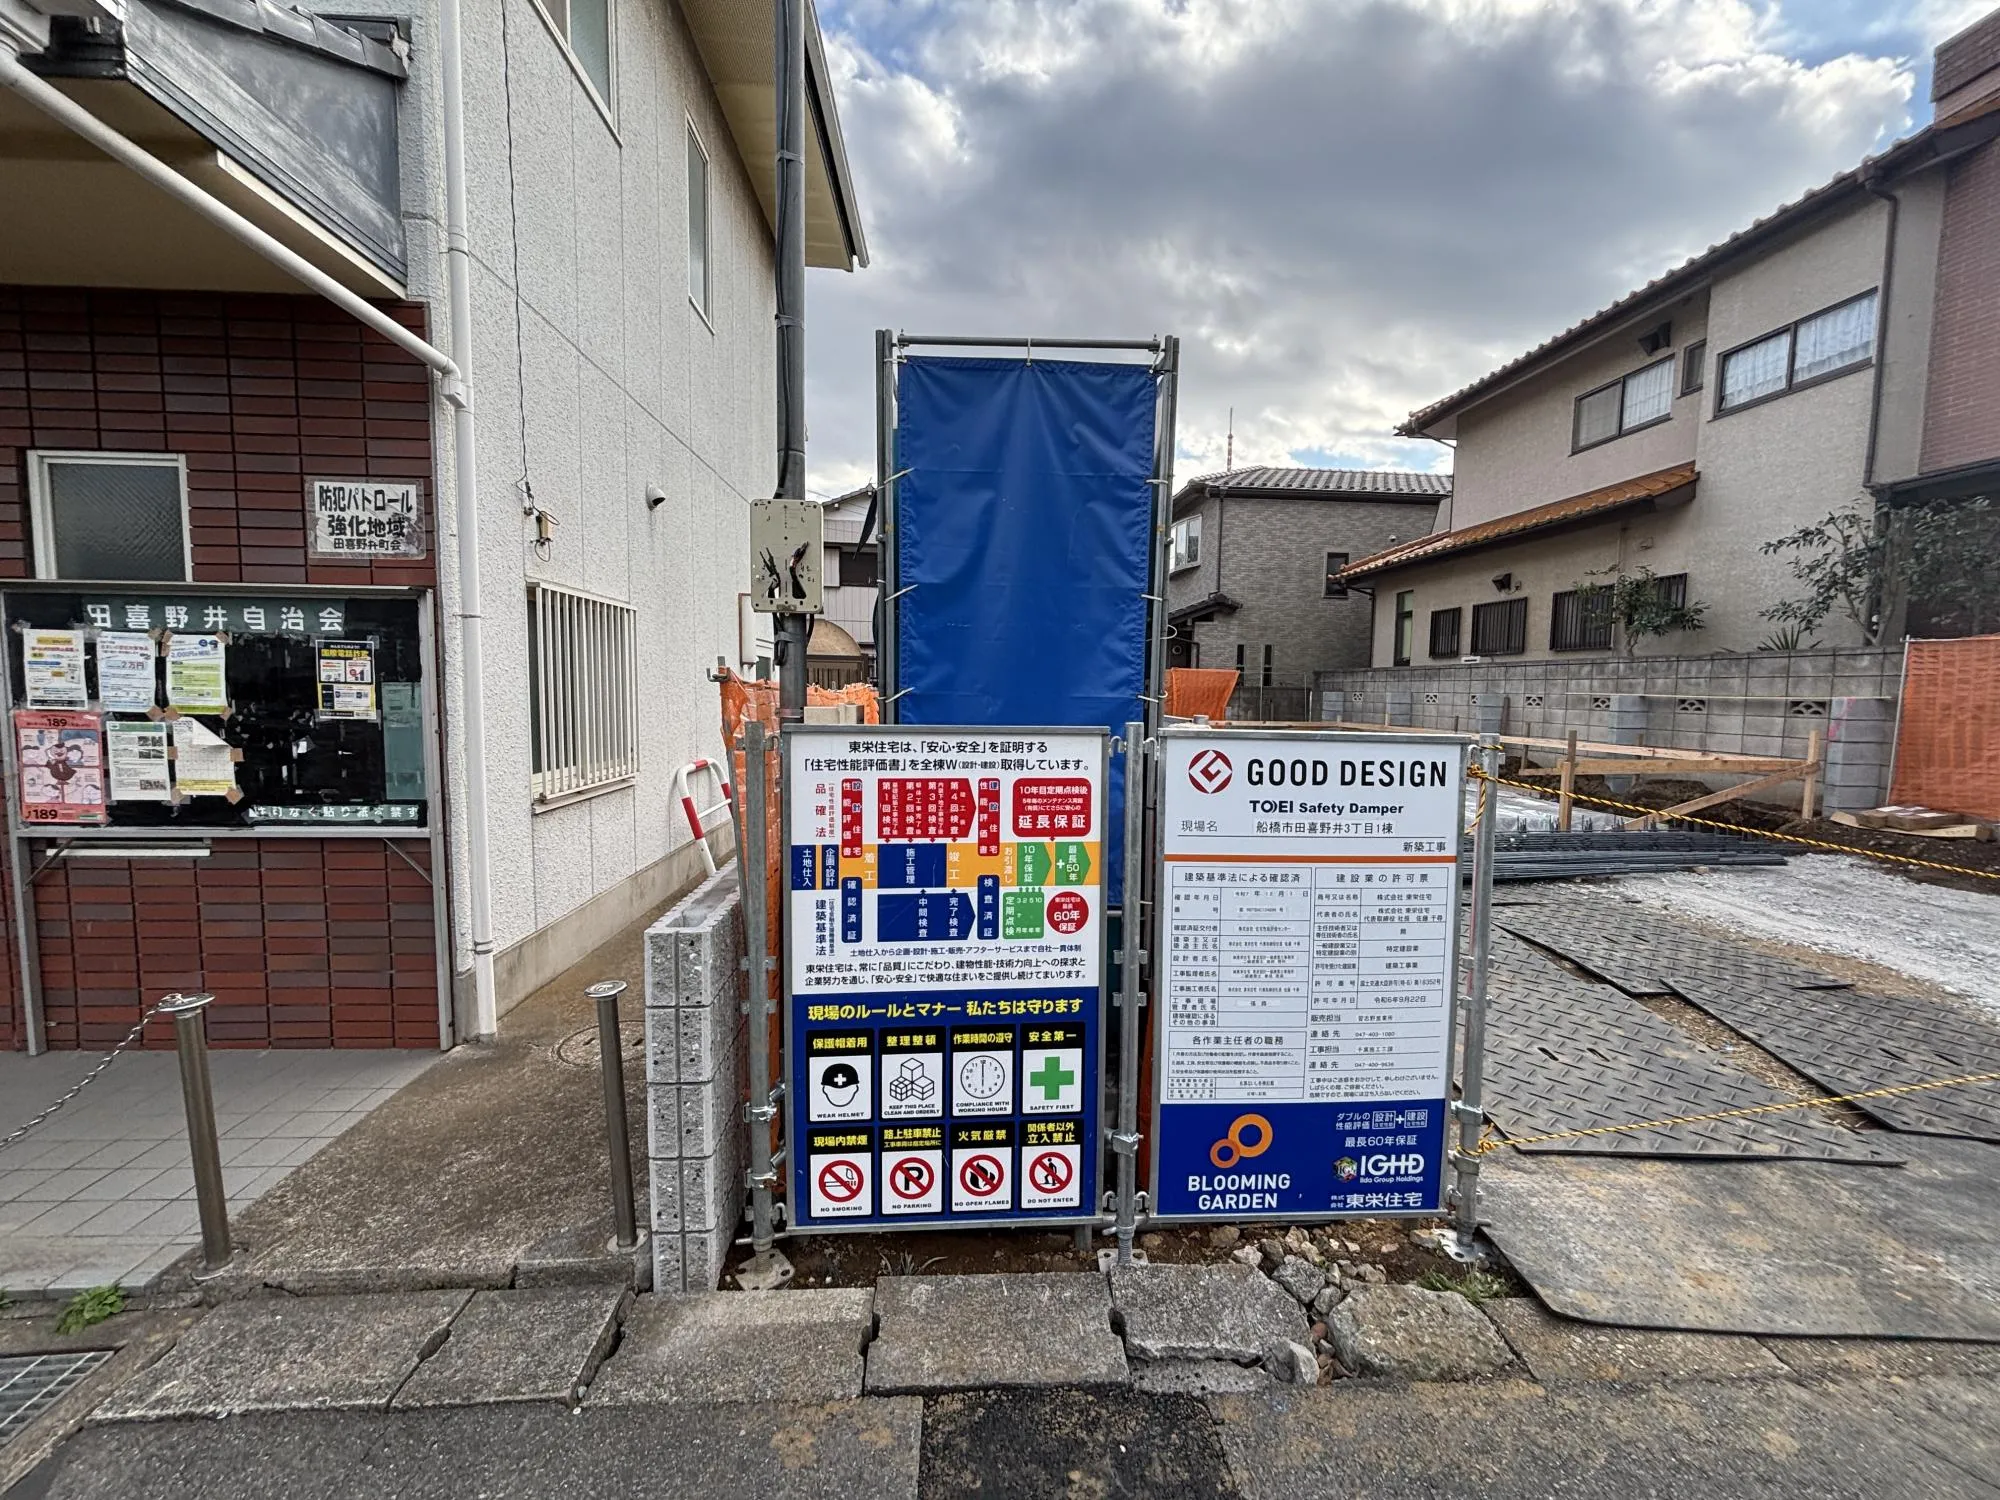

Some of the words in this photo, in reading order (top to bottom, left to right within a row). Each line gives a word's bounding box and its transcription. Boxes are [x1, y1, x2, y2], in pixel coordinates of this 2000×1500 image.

[319, 485, 413, 513] 防犯パトロール
[327, 515, 405, 538] 強化地域
[333, 538, 402, 551] 田喜野井町会
[86, 604, 344, 632] 田喜野井自治会
[121, 661, 145, 670] 2万円
[47, 718, 67, 727] 189
[849, 741, 1048, 754] 東栄住宅は、「安心・安全」を証明する
[1247, 758, 1329, 787] GOOD
[1340, 760, 1446, 788] DESIGN
[1019, 785, 1089, 795] 10年目定期点検後
[33, 809, 58, 820] 189
[815, 783, 827, 838] 品確法
[882, 781, 891, 836] 第1回検査
[906, 781, 915, 835] 第2回検査
[928, 781, 937, 835] 第3回検査
[950, 781, 959, 835] 第4回検査
[1249, 800, 1294, 813] TOEI
[1298, 803, 1344, 816] Safety
[1349, 803, 1404, 816] Damper
[1018, 815, 1087, 829] 延長保証
[1181, 820, 1218, 832] 現場名
[1256, 821, 1394, 834] 船橋市田喜野井3丁目1棟
[1402, 841, 1447, 853] 新築工事
[802, 848, 813, 887] 土地仕入
[825, 848, 836, 887] 企画・設計
[906, 848, 916, 885] 施工管理
[1003, 847, 1013, 884] お引渡し
[1023, 845, 1036, 883] 10年保証
[1066, 845, 1080, 882] 最長50年
[1184, 872, 1301, 883] 建築基準法による確認済
[1336, 873, 1429, 883] 建設業の許可票
[847, 880, 857, 940] 確認済証
[983, 877, 993, 937] 検査済証
[918, 898, 928, 938] 中間検査
[949, 897, 959, 937] 完了検査
[1005, 896, 1015, 936] 定期点検
[1053, 911, 1081, 921] 60年
[815, 899, 827, 956] 建築基準法
[1059, 922, 1077, 932] 保証
[805, 958, 1087, 974] 東栄住宅は、常に「品質」にこだわり、建物性能・技術力向上への探求と
[804, 970, 1086, 987] 企業努力を通じ、「安心・安全」で快適な住まいをご提供し続けてまいります。
[808, 1002, 961, 1021] 現場のルールとマナー
[966, 998, 1084, 1017] 私たちは守ります
[886, 1034, 937, 1047] 整理整頓
[1028, 1030, 1077, 1042] 安全第一
[1192, 1036, 1284, 1046] 各作業主任者の職務
[1311, 1030, 1341, 1038] 連絡先
[813, 1036, 868, 1050] 保護帽着用
[1309, 1061, 1340, 1069] 連絡先
[1337, 1112, 1371, 1121] ダブルの
[1374, 1112, 1394, 1123] 設計
[1406, 1111, 1426, 1121] 建設
[884, 1127, 941, 1139] 路上駐車禁止
[1027, 1122, 1075, 1132] 関係者以外
[1335, 1121, 1371, 1131] 性能評価
[813, 1135, 868, 1147] 現場内禁煙
[958, 1130, 1007, 1141] 火気厳禁
[1027, 1133, 1075, 1144] 立入禁止
[1344, 1134, 1418, 1148] 最長60年保証
[1360, 1153, 1425, 1176] IGHD
[1187, 1173, 1291, 1192] BLOOMING
[1373, 1176, 1395, 1184] Group
[1395, 1175, 1424, 1183] Holdings
[1198, 1192, 1278, 1211] GARDEN
[1345, 1191, 1423, 1209] 東栄住宅
